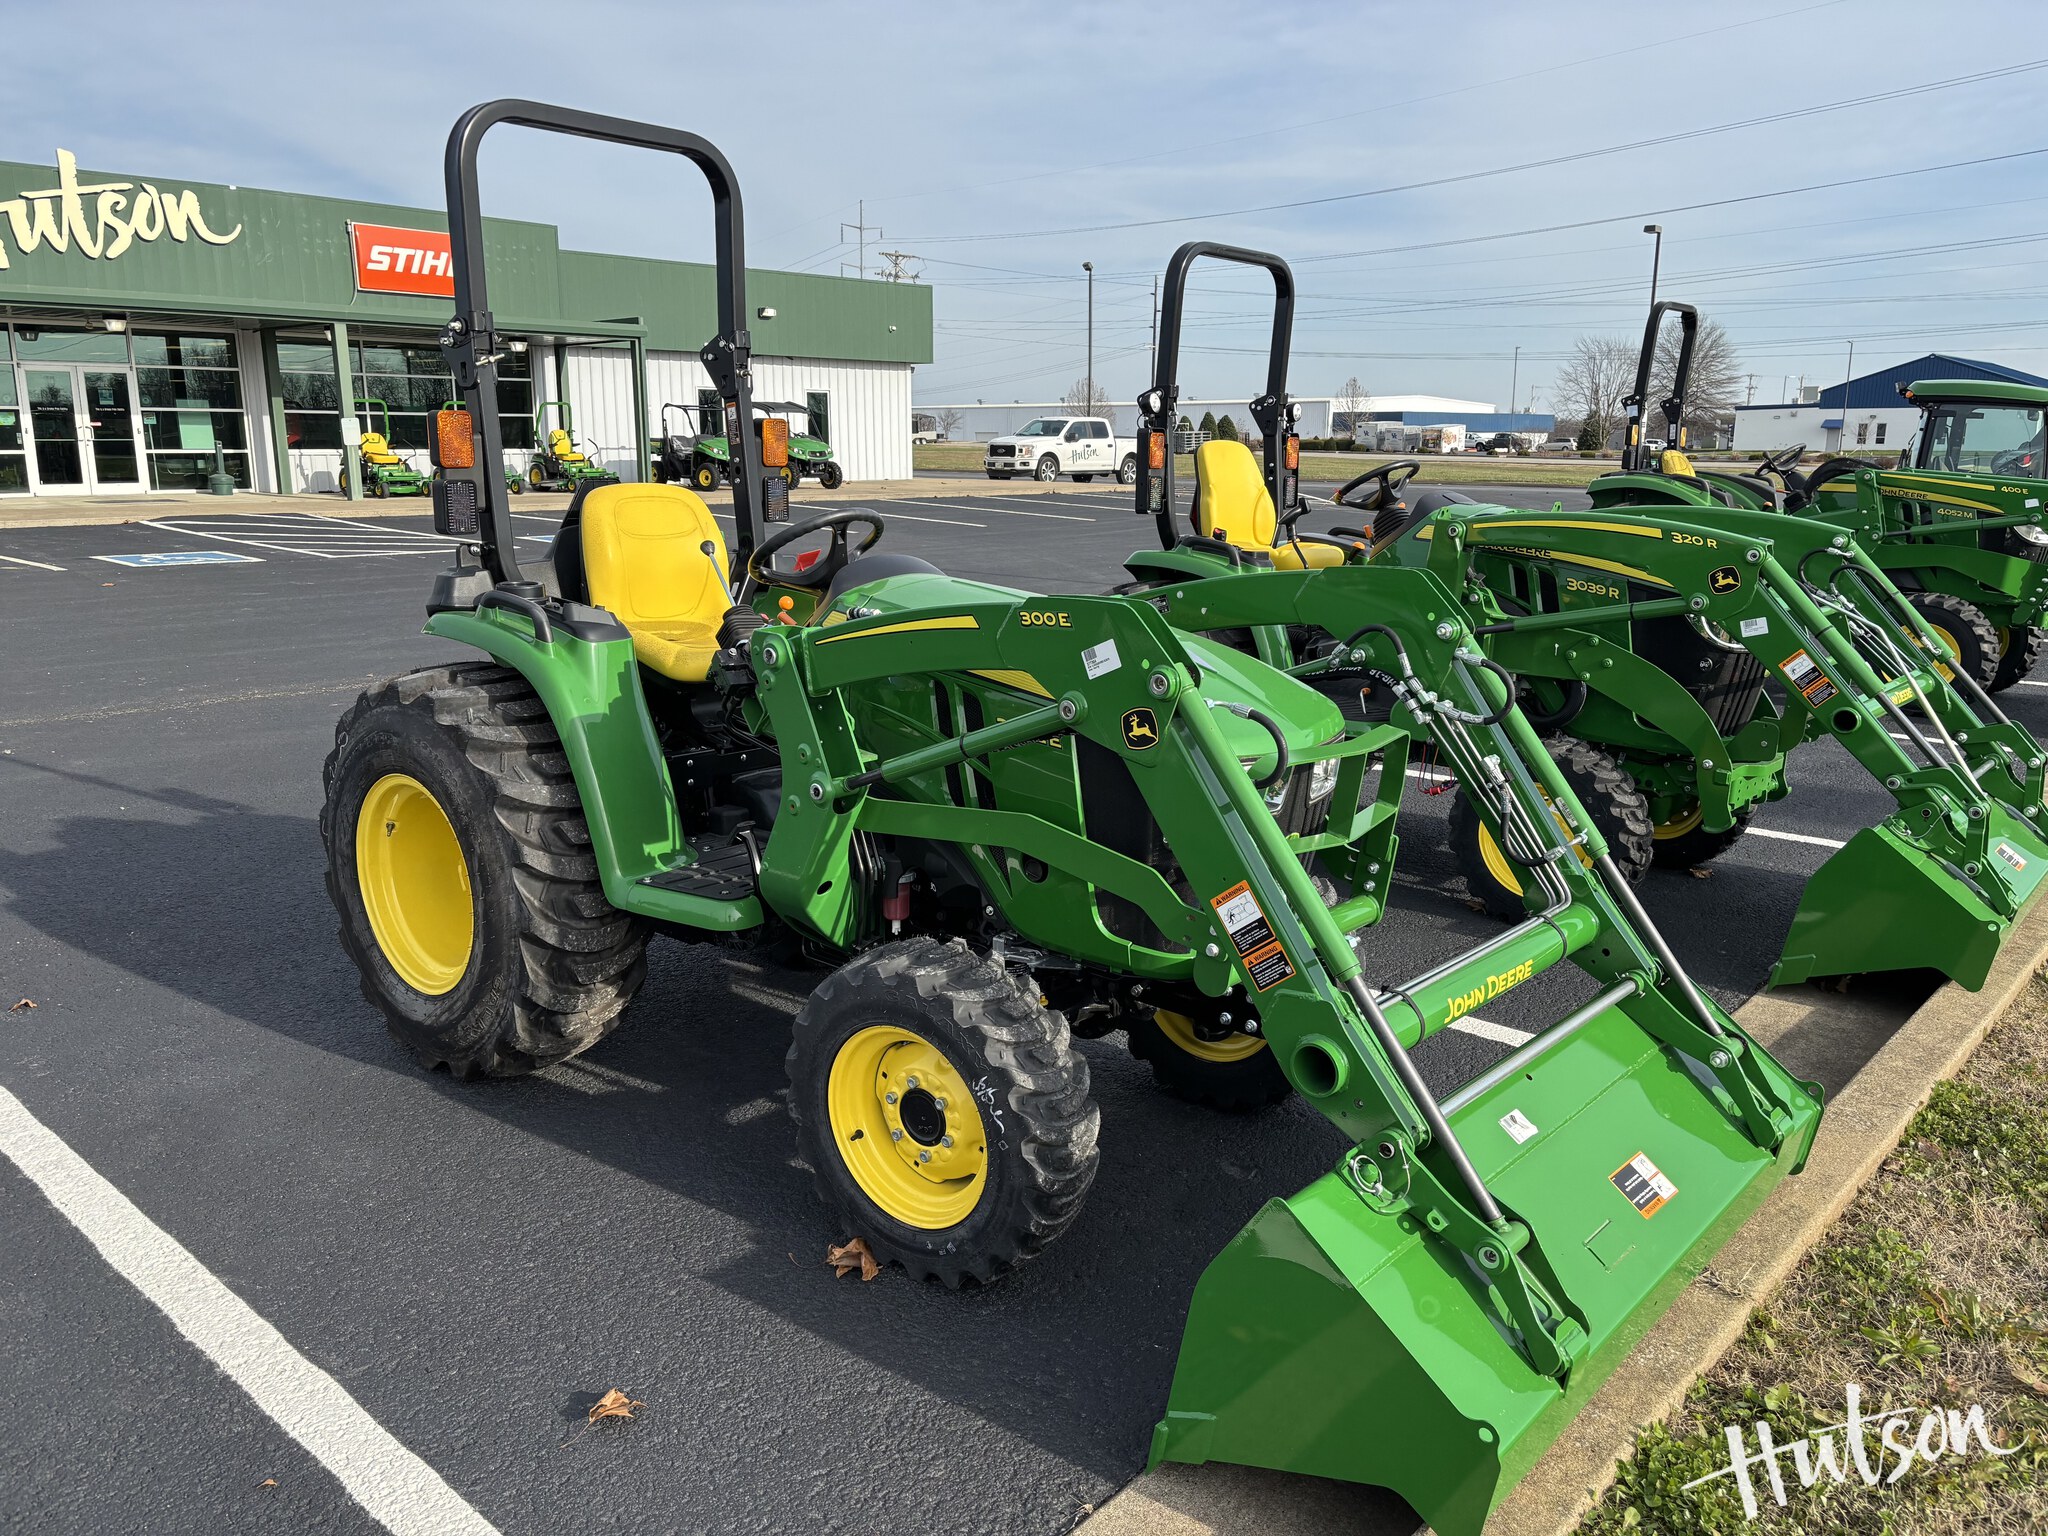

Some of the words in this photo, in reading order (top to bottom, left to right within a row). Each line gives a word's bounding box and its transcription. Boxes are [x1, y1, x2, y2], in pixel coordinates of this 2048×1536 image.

[0, 148, 242, 269] utson
[2001, 485, 2021, 494] 400
[1937, 508, 1962, 517] 4052
[1963, 511, 1973, 519] M
[1671, 532, 1703, 547] 320
[1706, 537, 1718, 549] R
[1566, 577, 1605, 596] 3039
[1608, 586, 1620, 600] R
[1019, 611, 1056, 627] 300
[1058, 612, 1072, 627] E
[1221, 885, 1244, 902] WARNING
[1253, 946, 1278, 962] WARNING
[1444, 985, 1485, 1024] JOHN
[1486, 959, 1534, 999] DEERE
